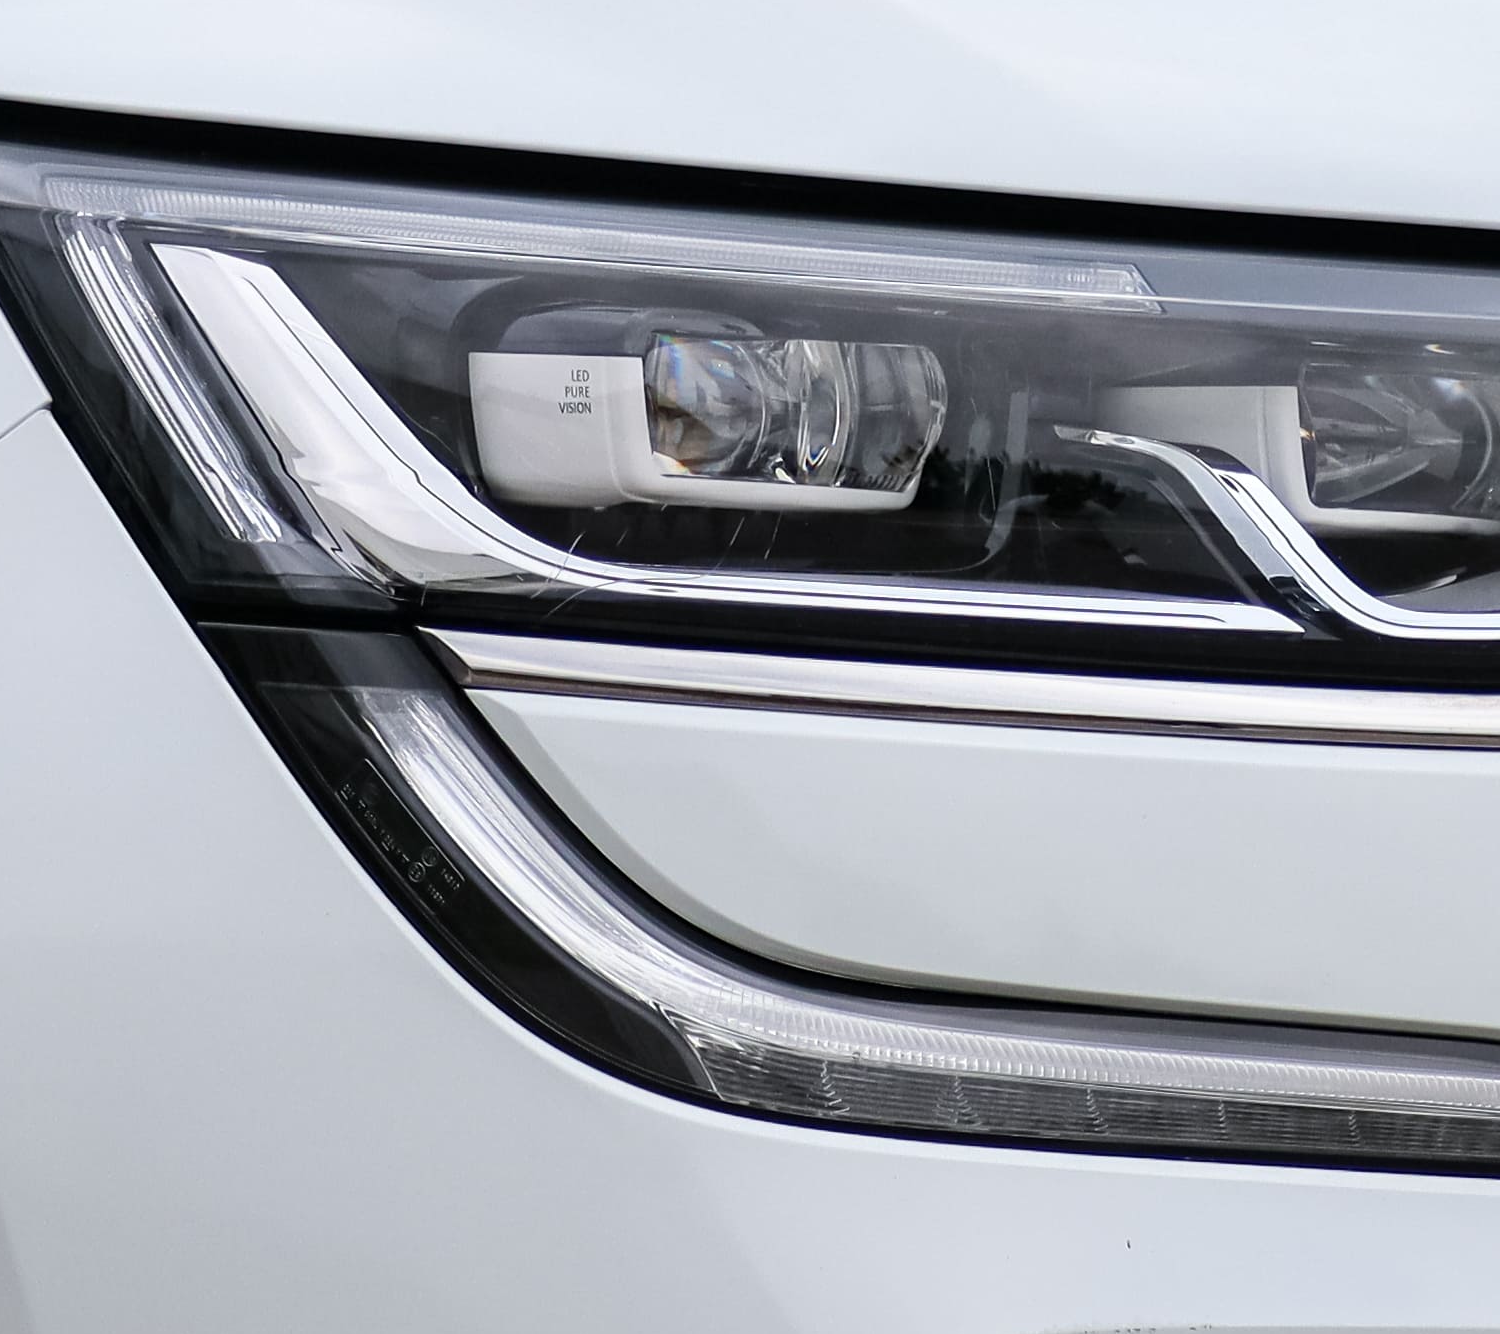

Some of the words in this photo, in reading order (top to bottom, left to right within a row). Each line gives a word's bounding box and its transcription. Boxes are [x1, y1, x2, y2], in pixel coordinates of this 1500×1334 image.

[571, 369, 590, 383] LED
[564, 386, 591, 399] PURE
[558, 401, 592, 415] VISION
